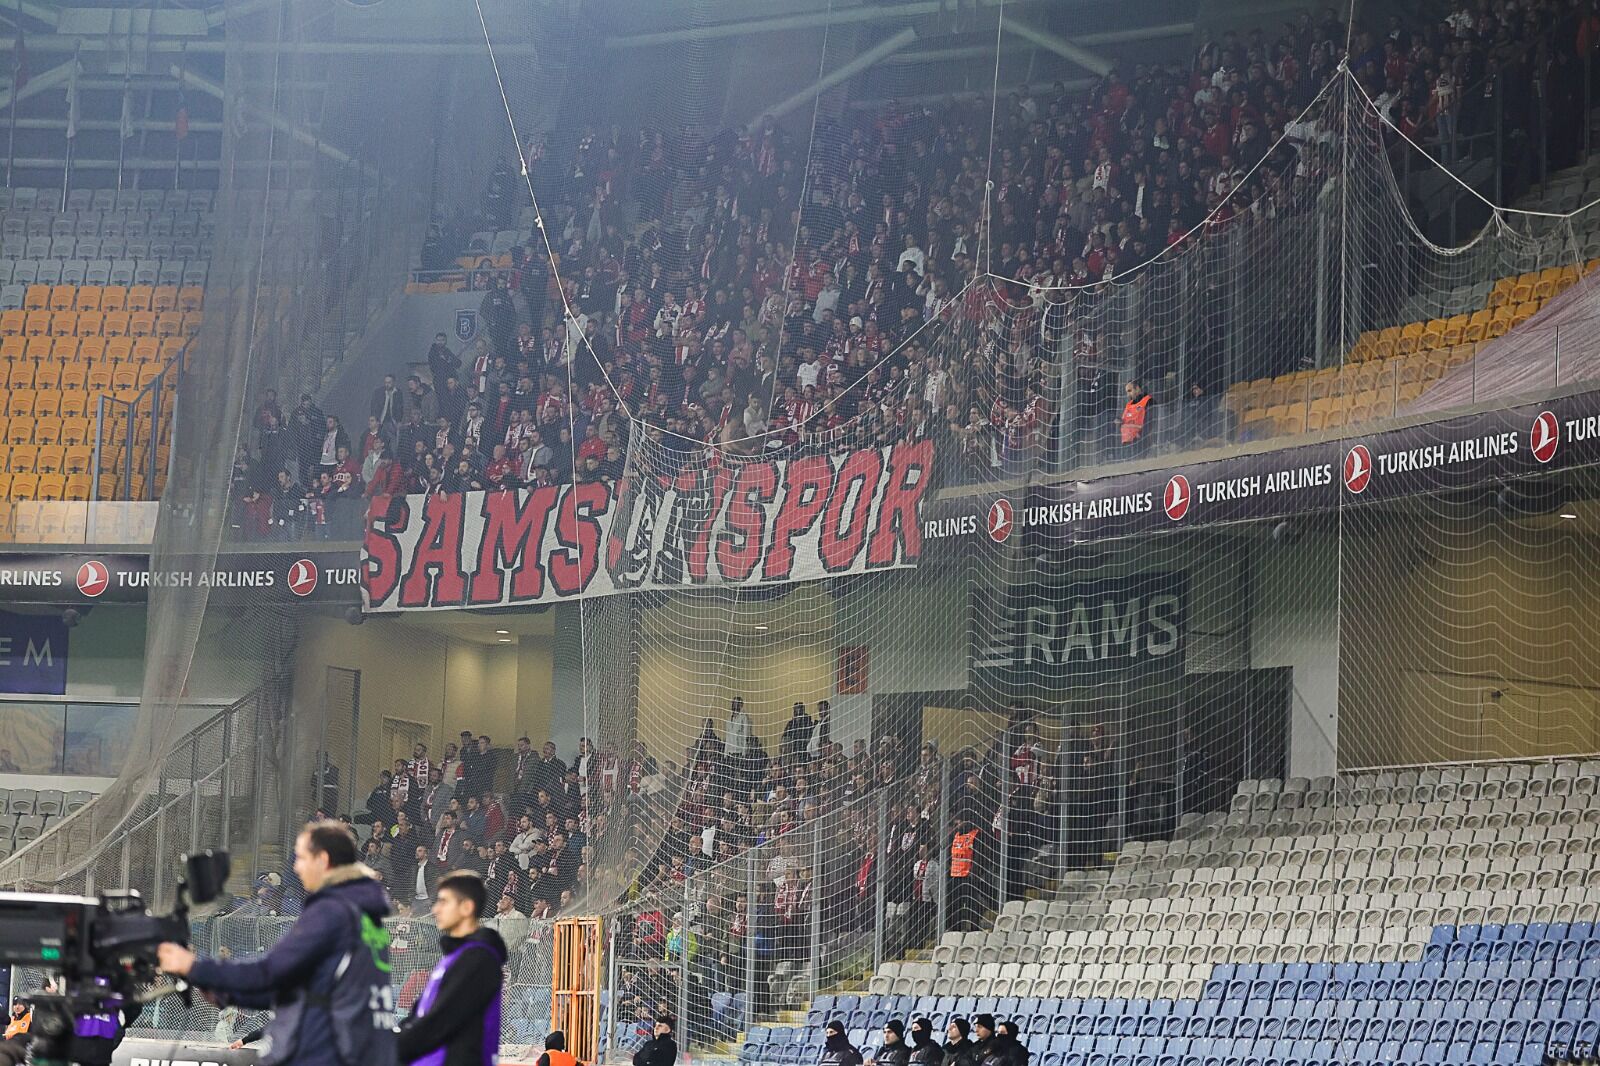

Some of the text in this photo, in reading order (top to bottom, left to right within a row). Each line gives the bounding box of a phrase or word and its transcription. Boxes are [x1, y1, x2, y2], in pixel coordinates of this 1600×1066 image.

[1378, 432, 1518, 475] TURKISH AIRLINES
[1197, 463, 1332, 504] TURKISH AIRLINES
[1022, 492, 1153, 527] TURKISH AIRLINES
[0, 570, 62, 586] RLINES
[116, 570, 275, 587] TURKISH AIRLINES
[325, 568, 361, 585] TUR
[1024, 594, 1179, 664] RAMS
